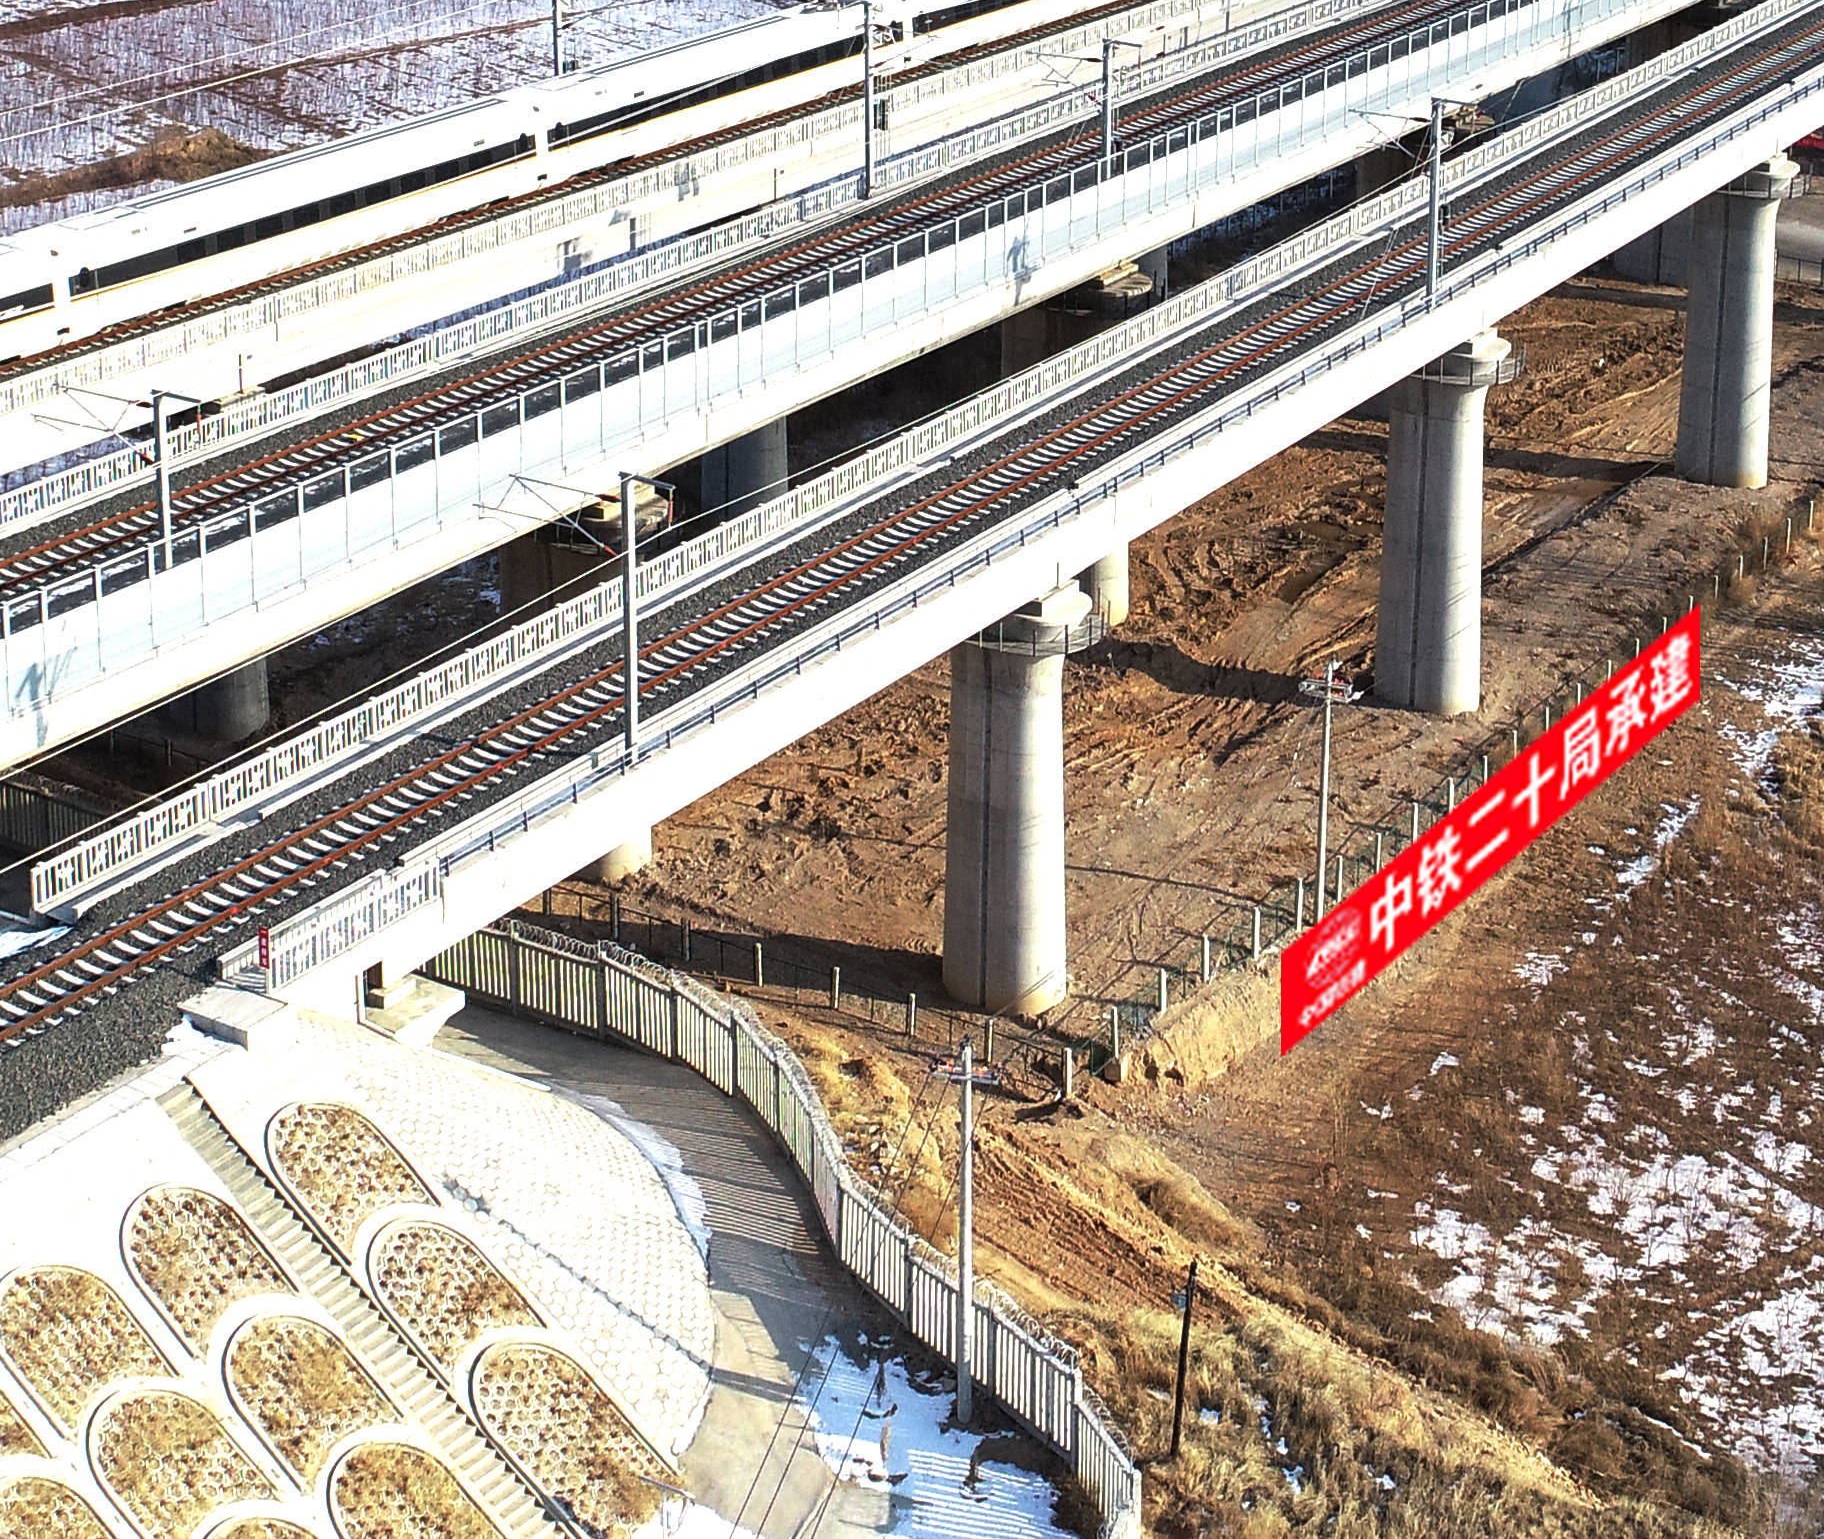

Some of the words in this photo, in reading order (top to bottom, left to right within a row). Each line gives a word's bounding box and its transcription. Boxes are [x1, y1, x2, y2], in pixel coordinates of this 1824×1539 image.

[1370, 632, 1693, 952] 中铁二十局承建
